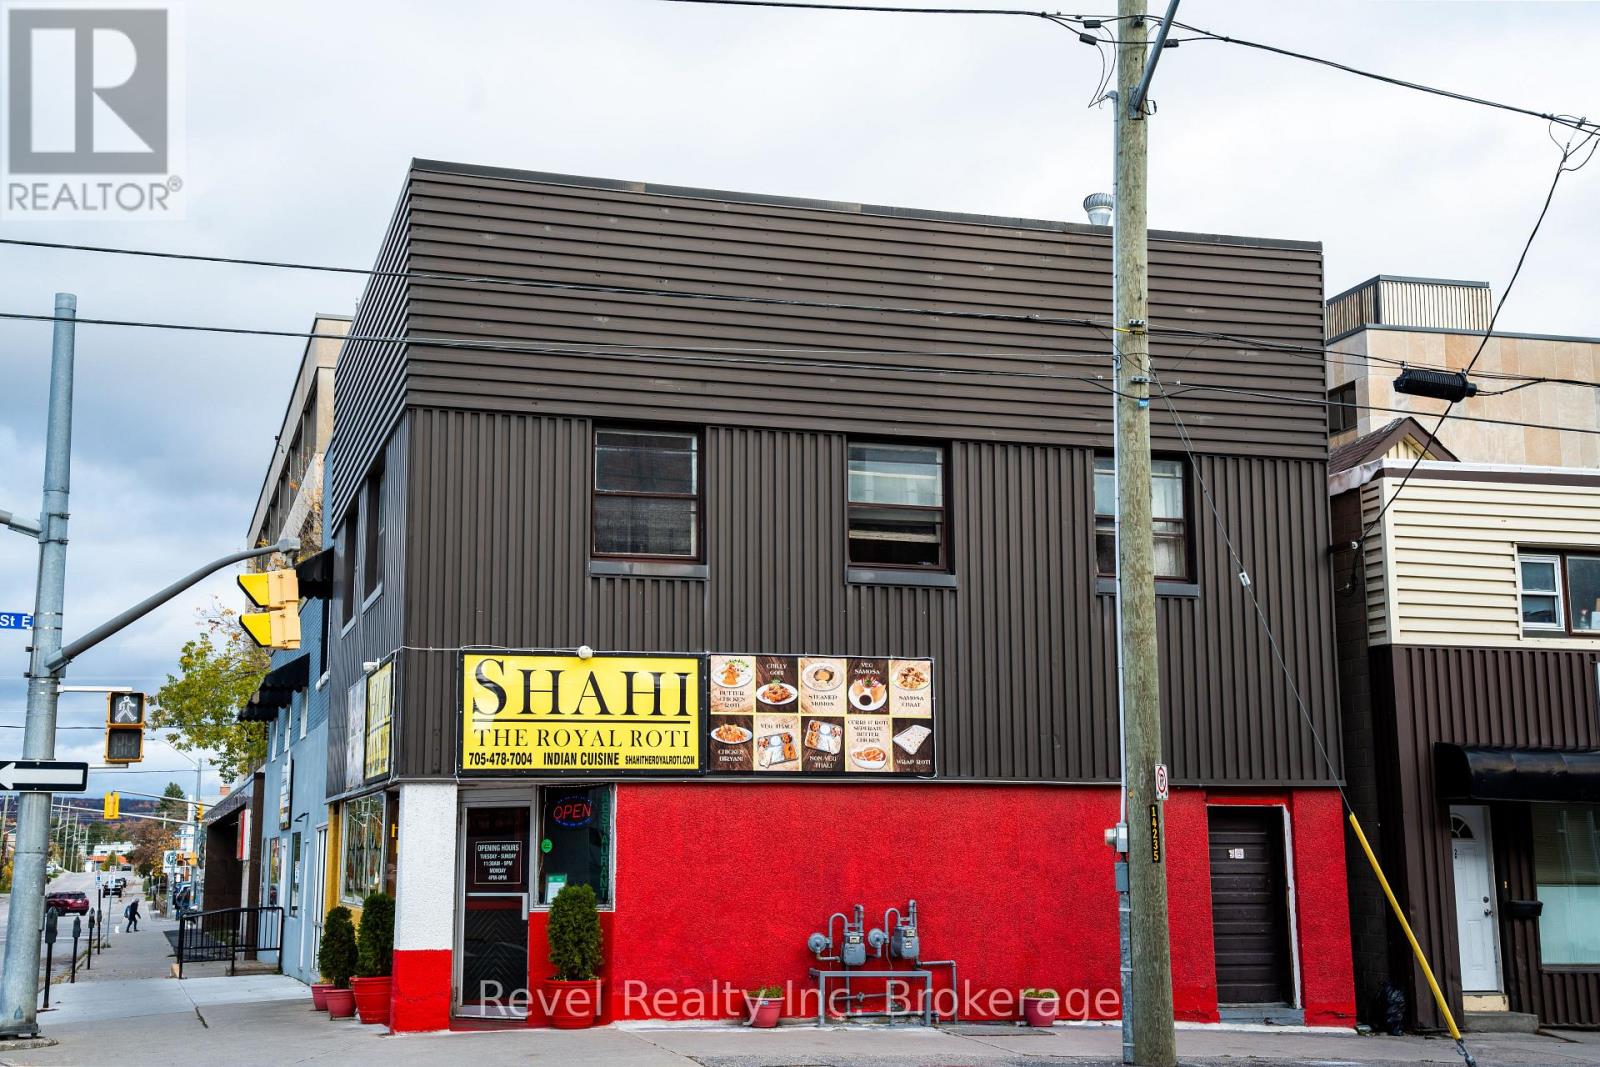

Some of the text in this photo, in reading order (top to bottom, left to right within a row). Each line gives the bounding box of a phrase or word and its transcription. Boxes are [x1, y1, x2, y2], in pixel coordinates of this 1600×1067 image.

[0, 615, 32, 627] St E
[473, 728, 690, 748] THE ROYAL ROTI
[468, 752, 695, 766] 705-478-7004 INDIAN CUISINE SHAHITHEROYALROTI.COM
[553, 803, 592, 819] OPEN
[1151, 806, 1159, 861] 14235
[477, 844, 501, 852] OPENING
[600, 790, 609, 898] RESTAURANT
